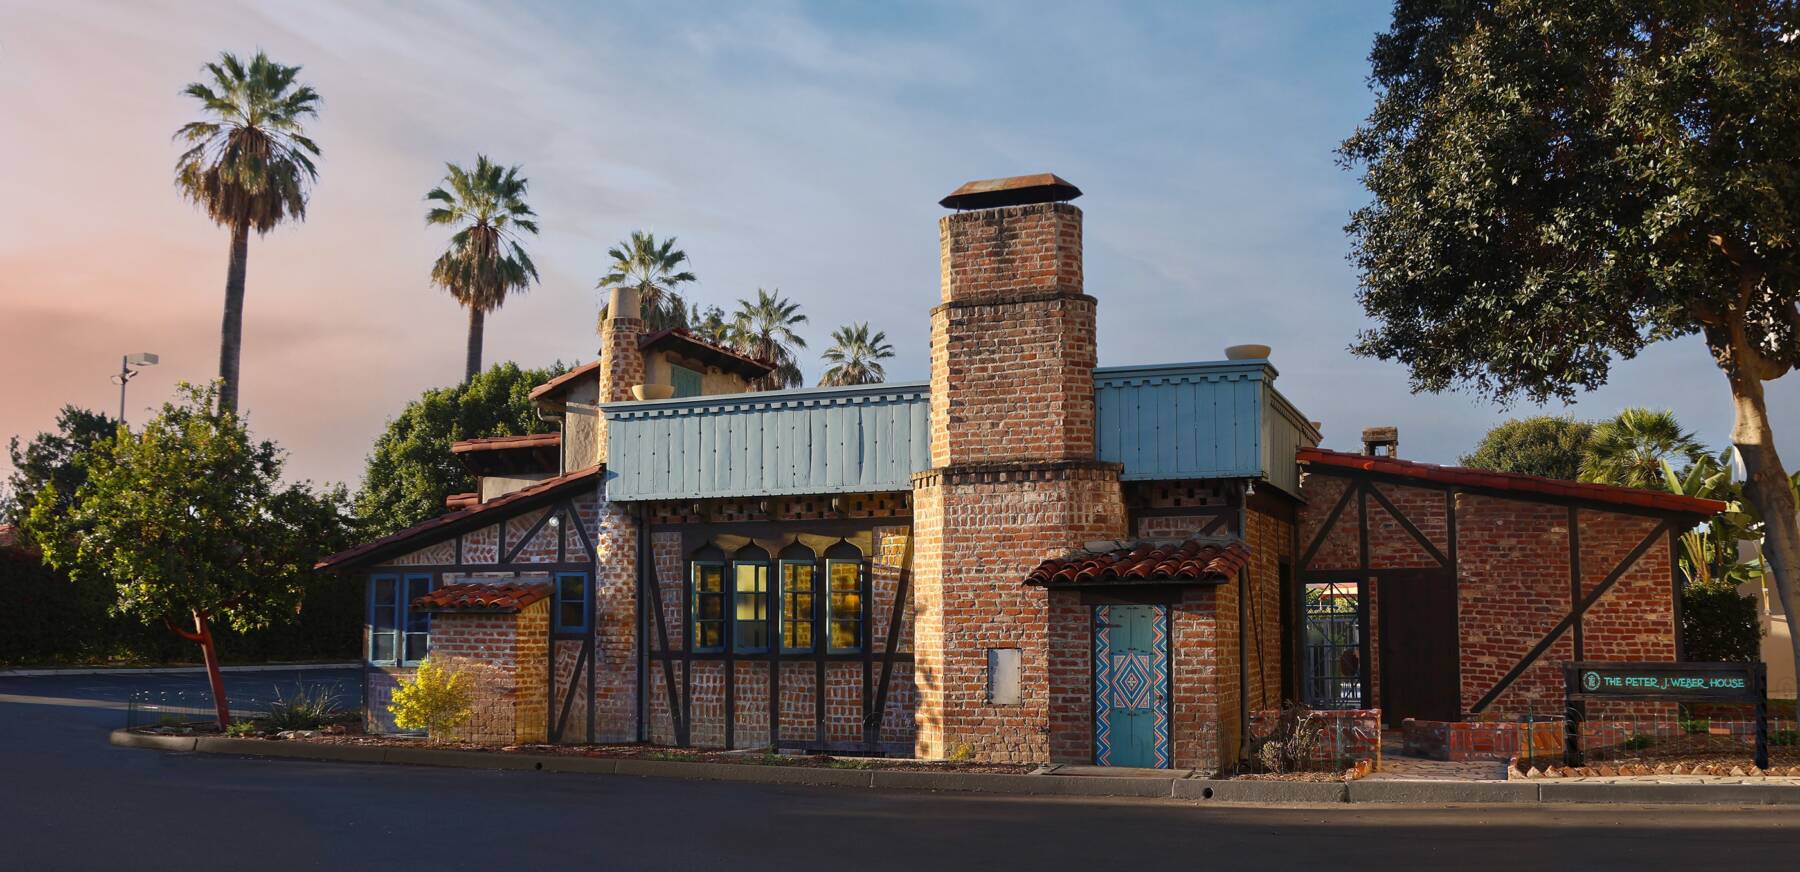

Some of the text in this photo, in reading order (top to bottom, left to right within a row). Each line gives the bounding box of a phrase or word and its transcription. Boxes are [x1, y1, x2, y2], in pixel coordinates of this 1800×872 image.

[1604, 677, 1622, 687] THE
[1625, 677, 1659, 688] PETER
[1670, 677, 1709, 689] WEBER
[1709, 678, 1745, 689] HOUSE
